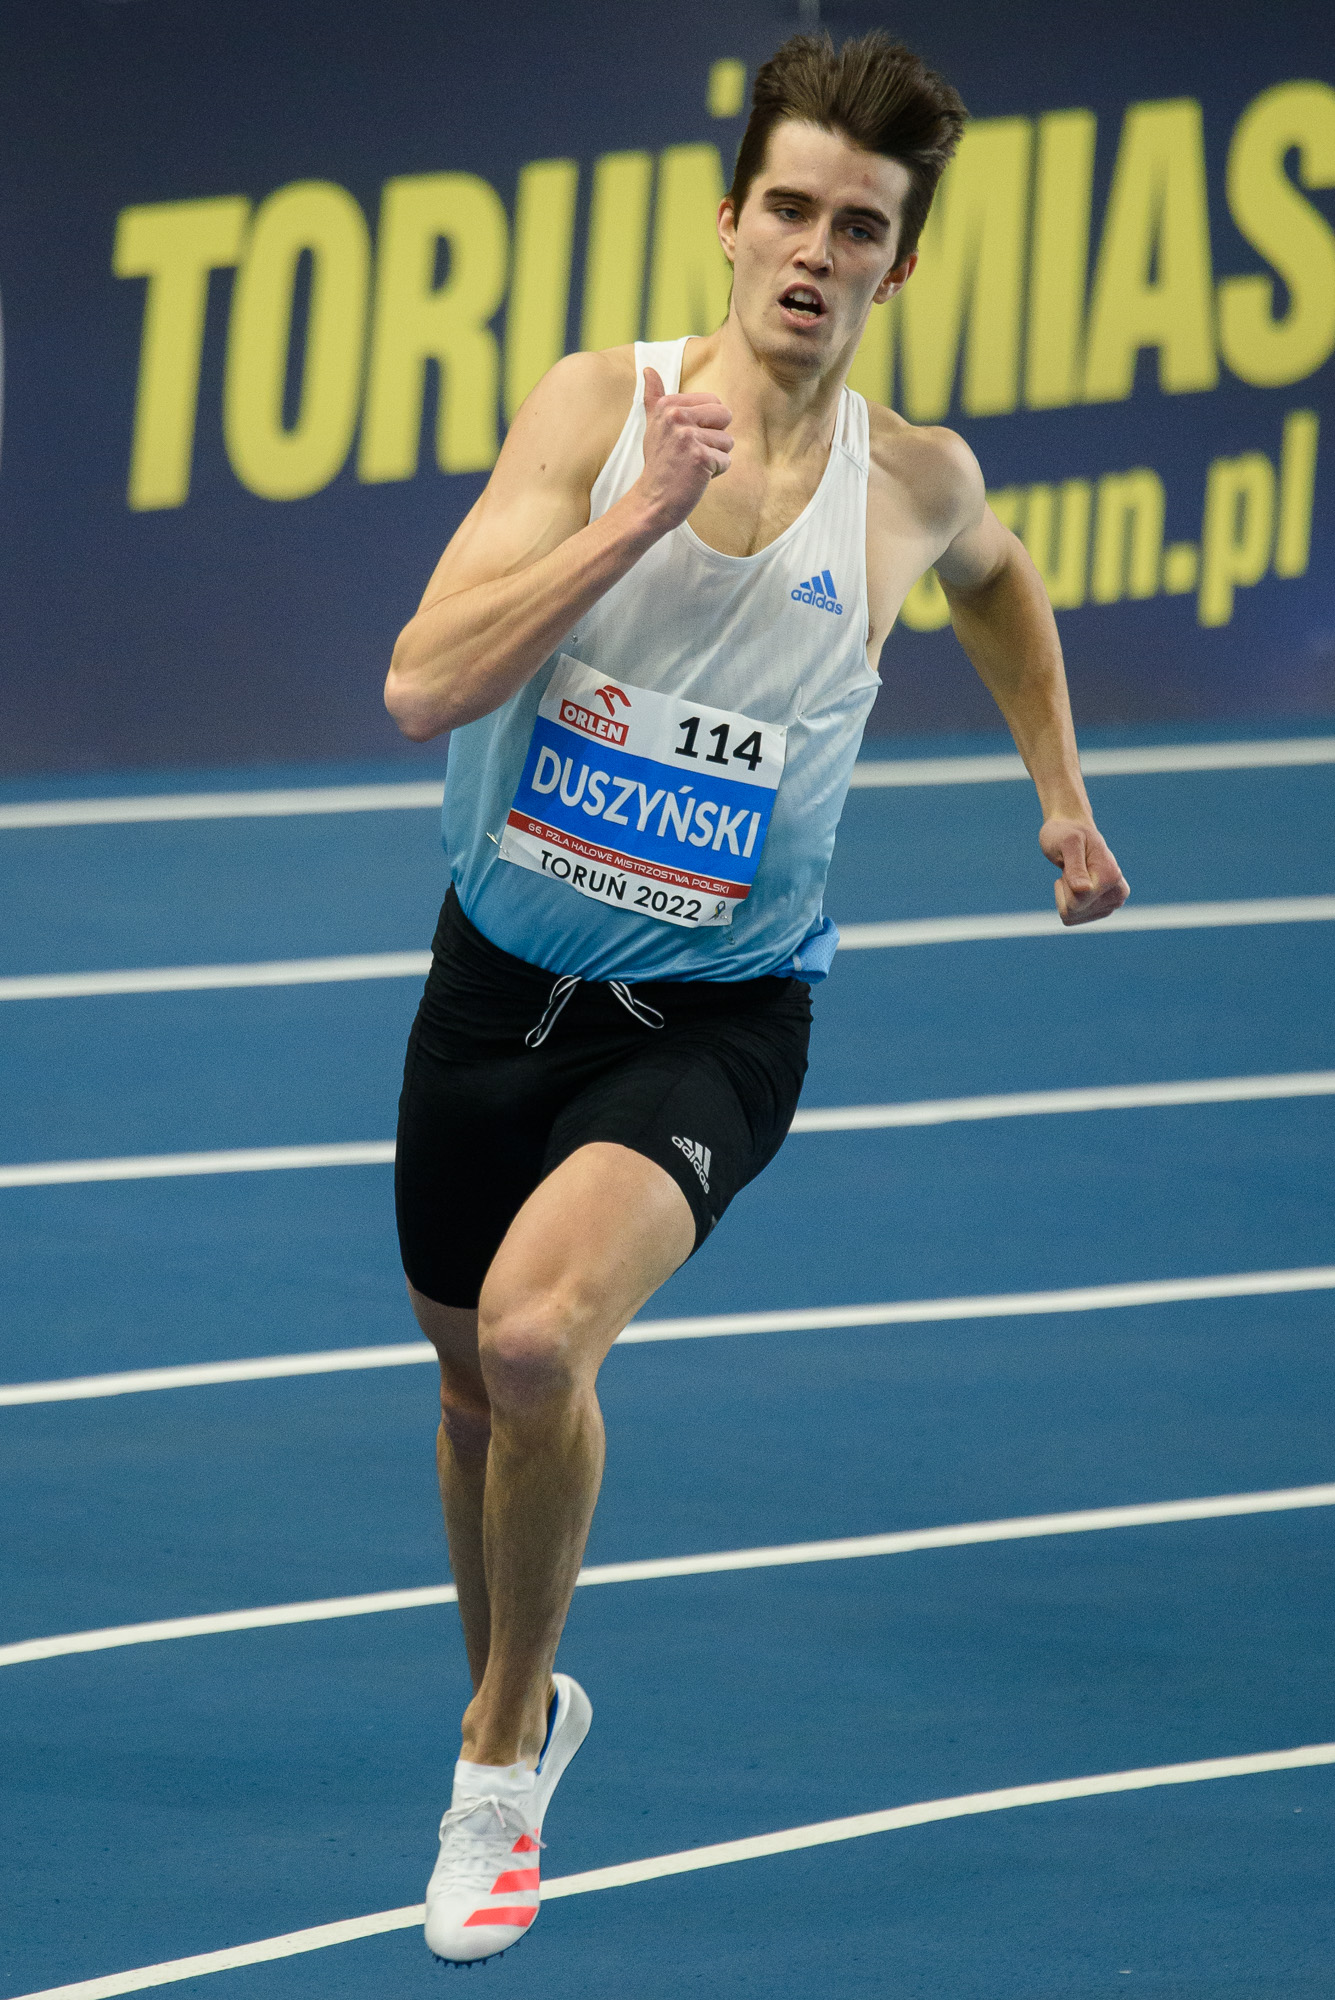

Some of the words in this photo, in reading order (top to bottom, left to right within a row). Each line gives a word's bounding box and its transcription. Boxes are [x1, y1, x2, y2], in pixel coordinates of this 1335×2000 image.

[791, 589, 843, 615] adidas
[562, 702, 625, 743] ORLEN
[674, 716, 763, 772] 114
[530, 745, 762, 859] DUSZYŃSKI
[528, 823, 544, 836] 66.
[545, 829, 570, 847] PZLA
[571, 841, 614, 863] HALOWE
[614, 857, 690, 886] MISTRZOSTWA
[691, 878, 730, 894] POLSKI
[541, 849, 628, 901] TORUŃ
[633, 885, 703, 922] 2022
[671, 1135, 710, 1194] adidas
